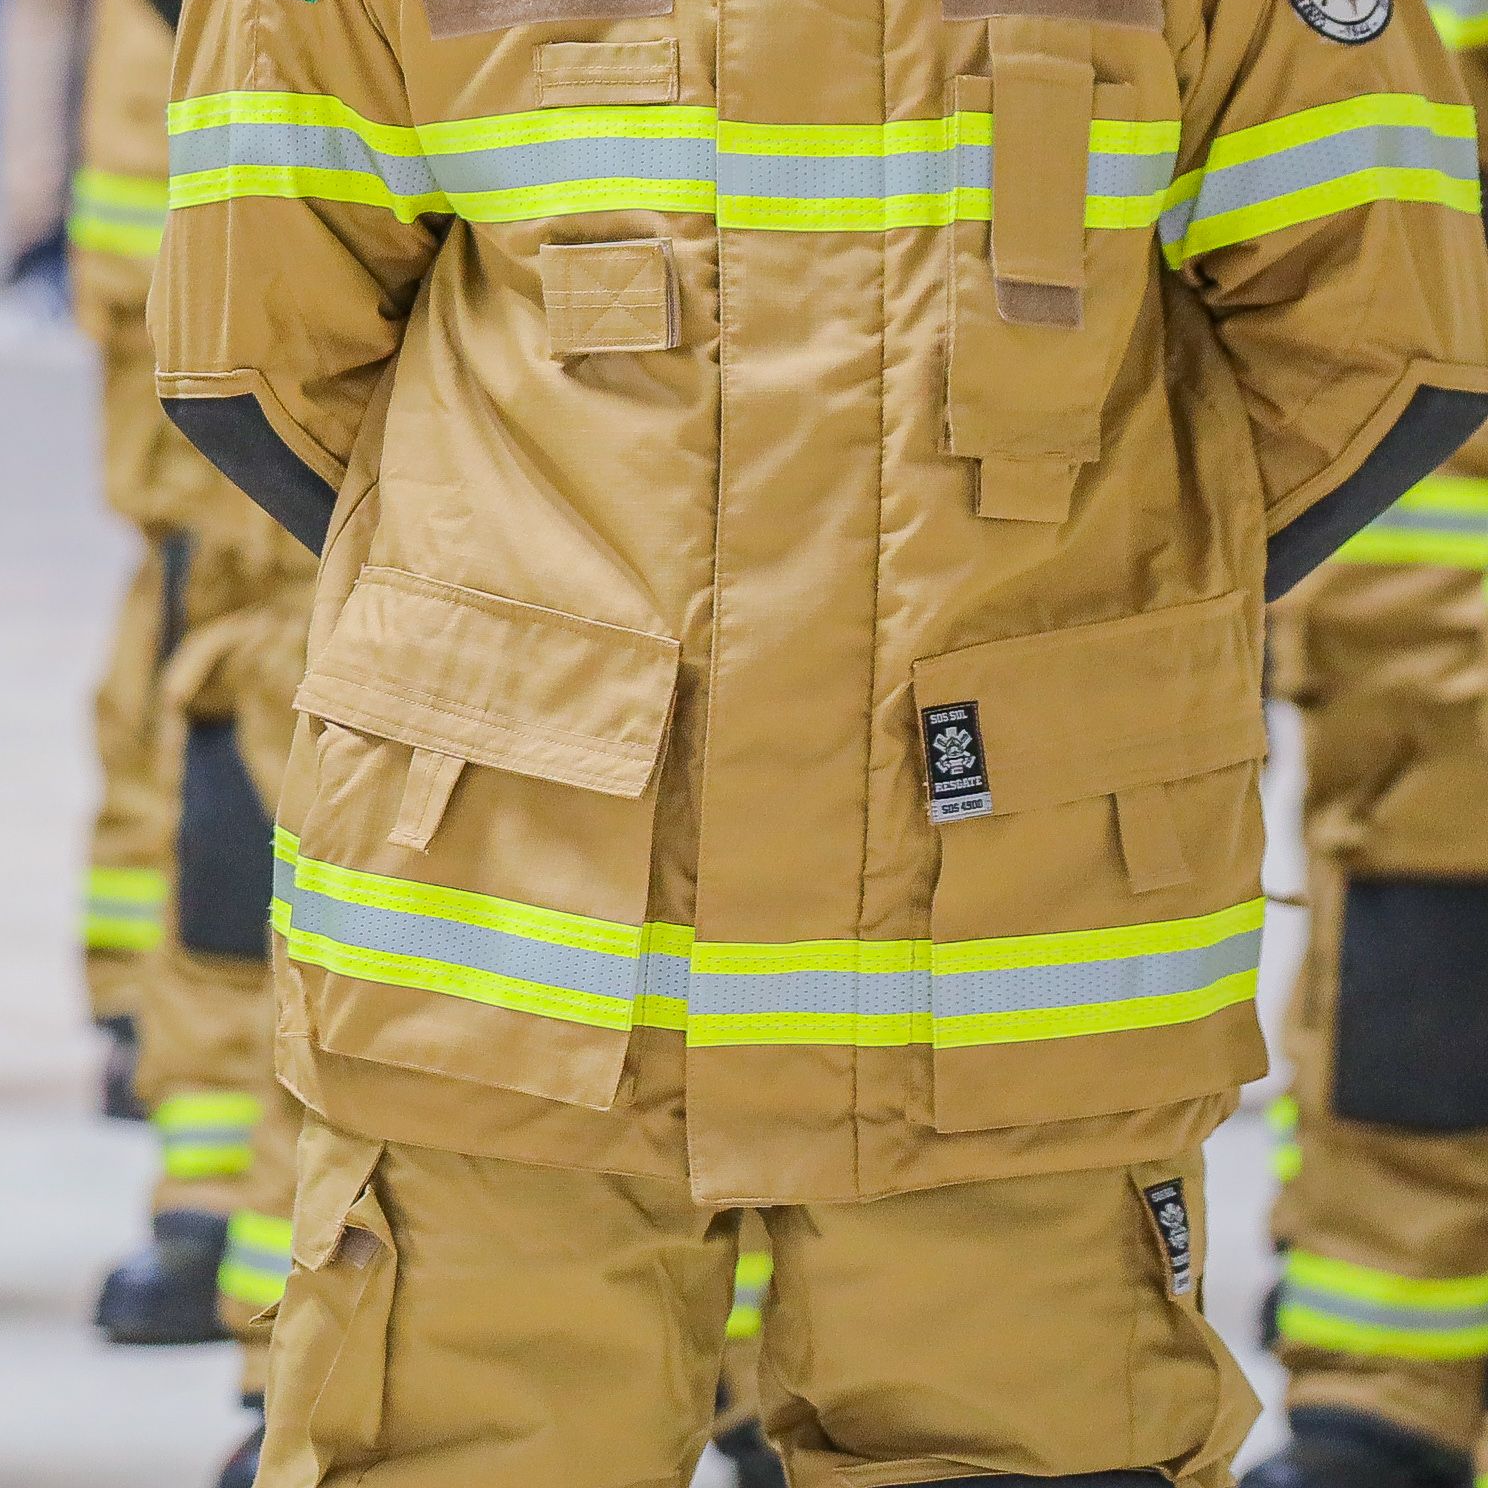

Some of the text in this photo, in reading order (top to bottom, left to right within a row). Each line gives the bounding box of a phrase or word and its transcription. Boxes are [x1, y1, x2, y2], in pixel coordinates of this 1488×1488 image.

[930, 709, 968, 725] SOS SUL
[934, 775, 983, 793] RESGATE
[941, 802, 960, 815] SOS
